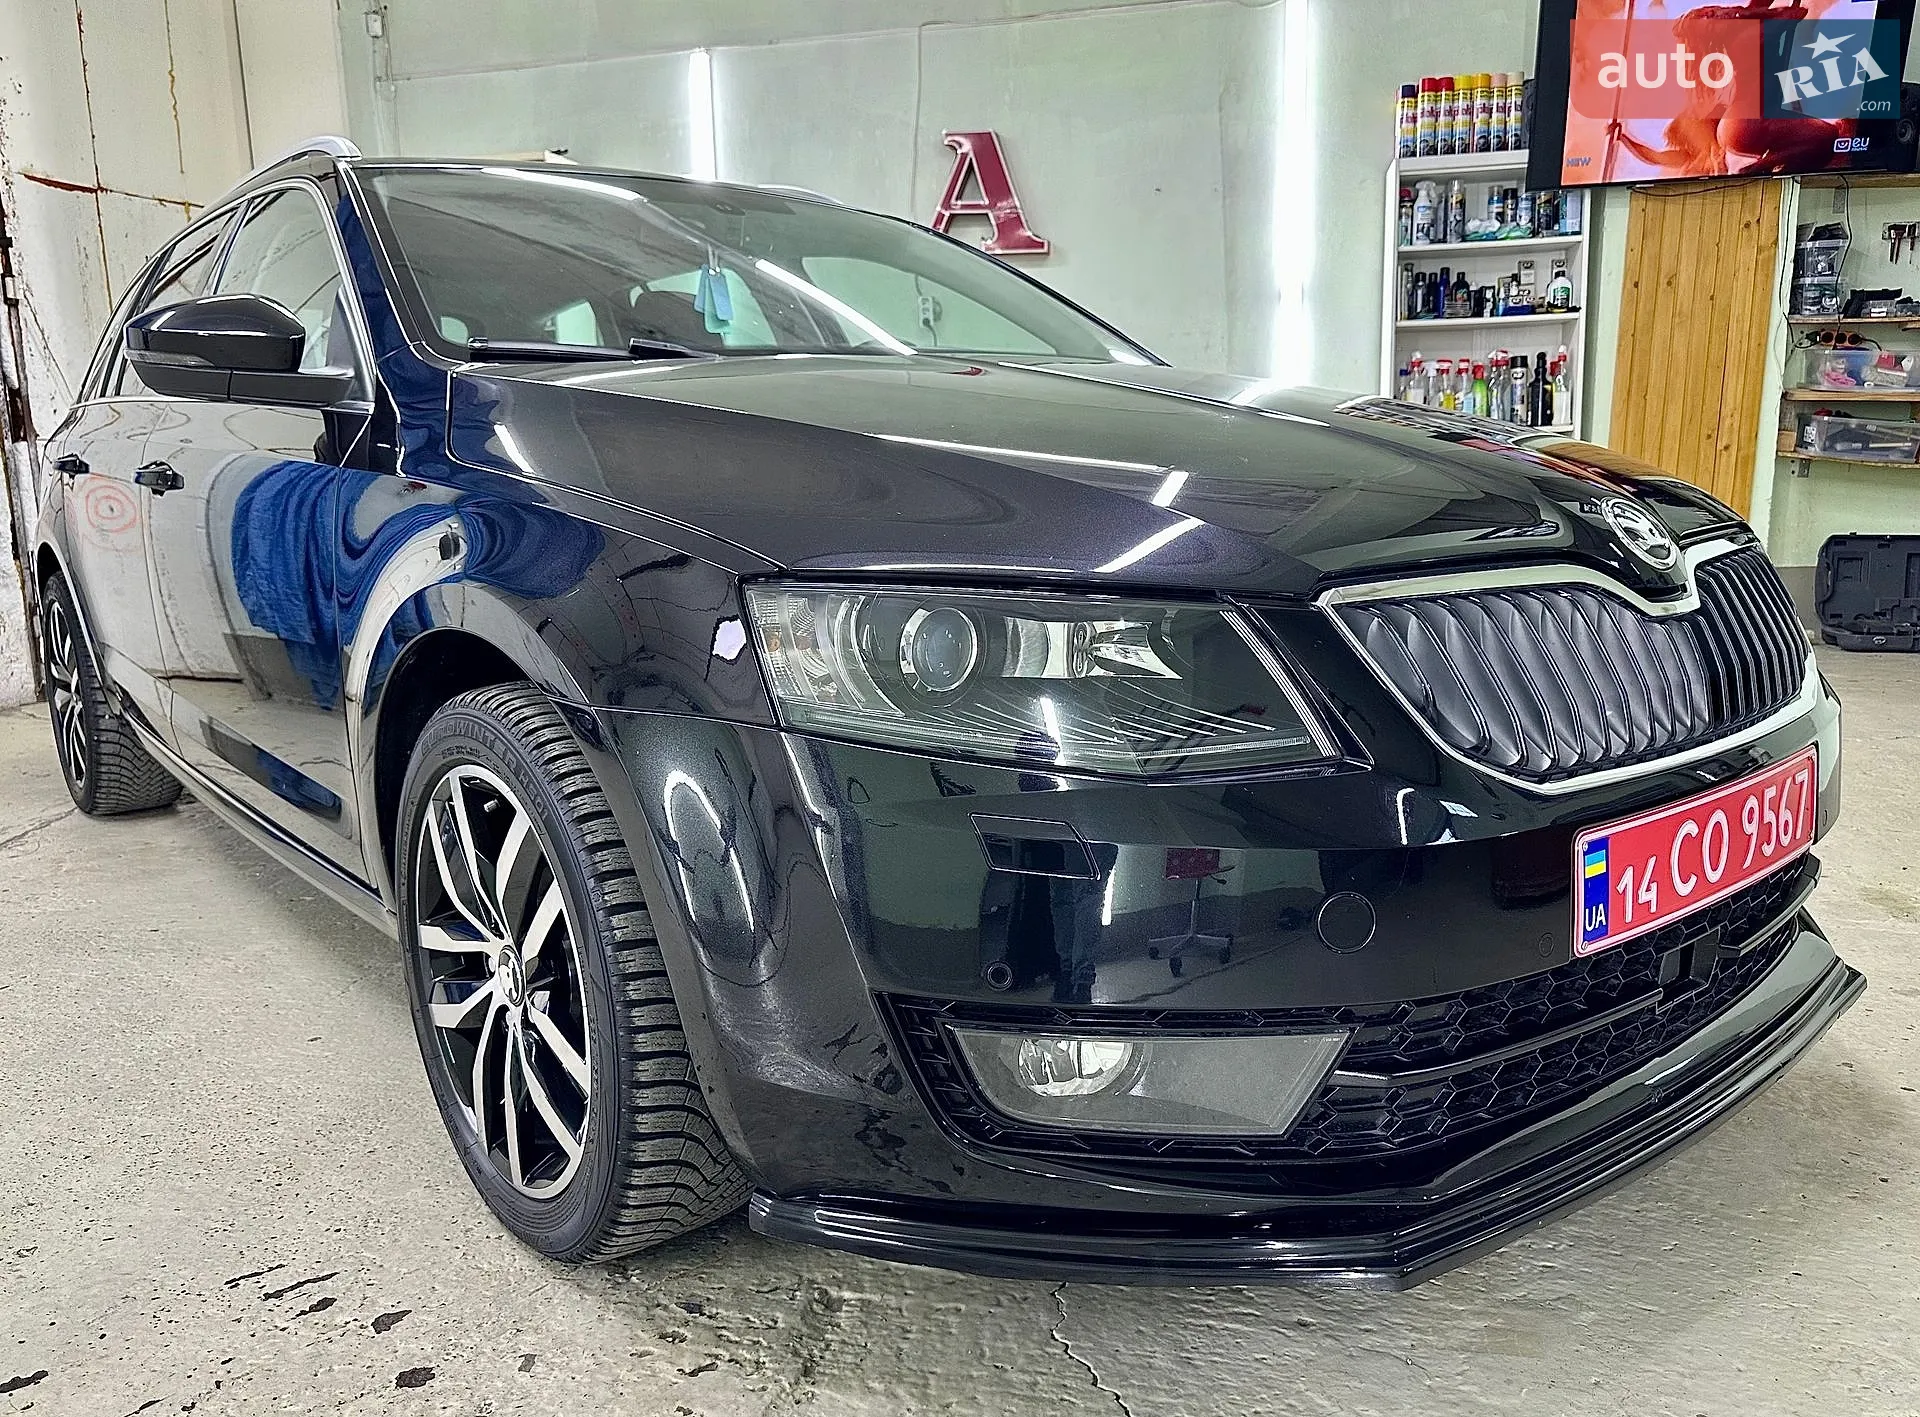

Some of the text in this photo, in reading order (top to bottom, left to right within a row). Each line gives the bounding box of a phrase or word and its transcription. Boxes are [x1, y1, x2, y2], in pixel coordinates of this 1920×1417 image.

[931, 130, 1050, 254] A
[1616, 768, 1809, 923] 14 CO 9567
[1585, 903, 1607, 932] UA
